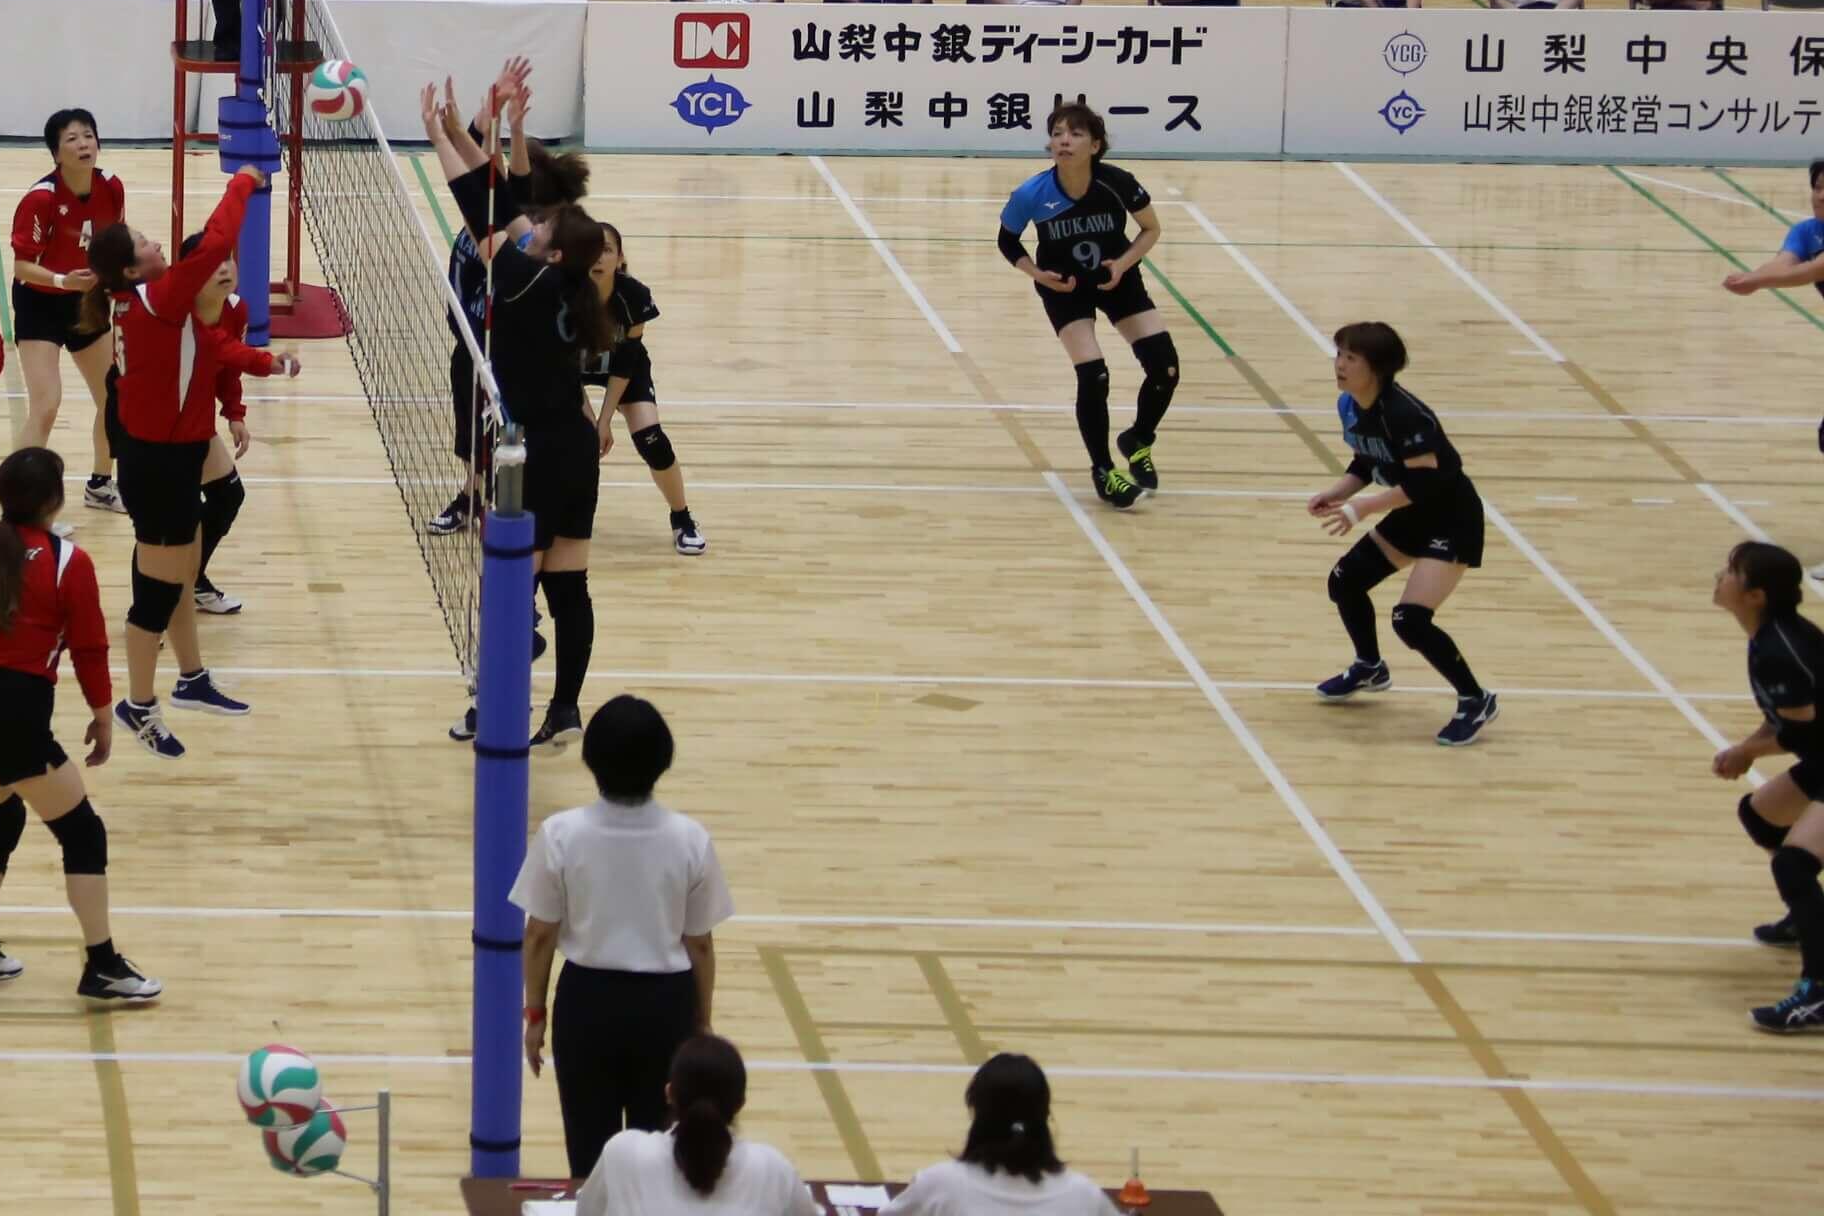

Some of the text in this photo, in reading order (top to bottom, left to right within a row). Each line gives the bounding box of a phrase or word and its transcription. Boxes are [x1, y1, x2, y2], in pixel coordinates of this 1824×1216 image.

[682, 21, 741, 60] DC
[792, 22, 1209, 65] 山梨中銀ディーシーカード
[1390, 44, 1421, 63] YCG
[1464, 33, 1824, 76] 山梨中央保
[682, 91, 740, 117] YCL
[1391, 106, 1413, 119] YC
[1463, 93, 1823, 136] 山梨中銀経営コンサルテ
[1047, 212, 1116, 241] MUKAWA
[1072, 240, 1102, 272] 9
